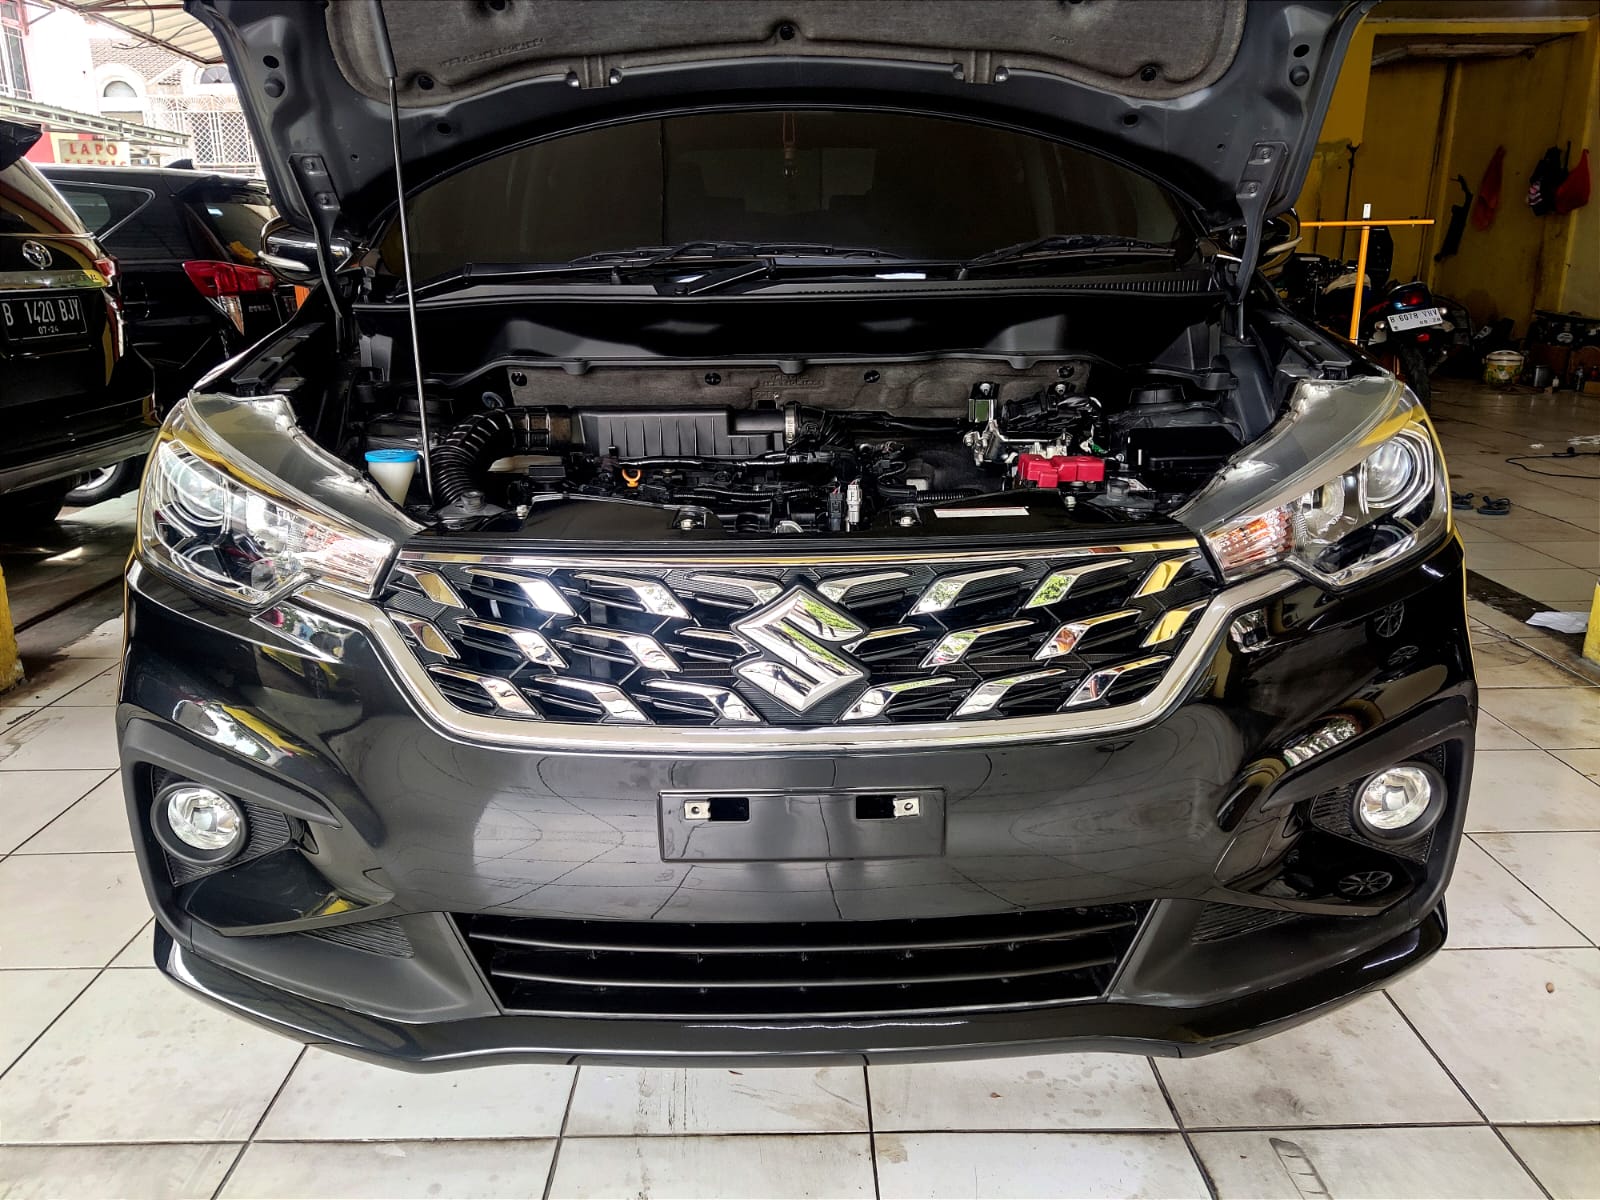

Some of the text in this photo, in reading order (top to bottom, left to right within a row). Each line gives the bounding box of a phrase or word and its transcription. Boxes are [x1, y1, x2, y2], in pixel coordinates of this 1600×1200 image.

[69, 143, 118, 156] LAPO
[1, 298, 81, 327] B 1420 BJY
